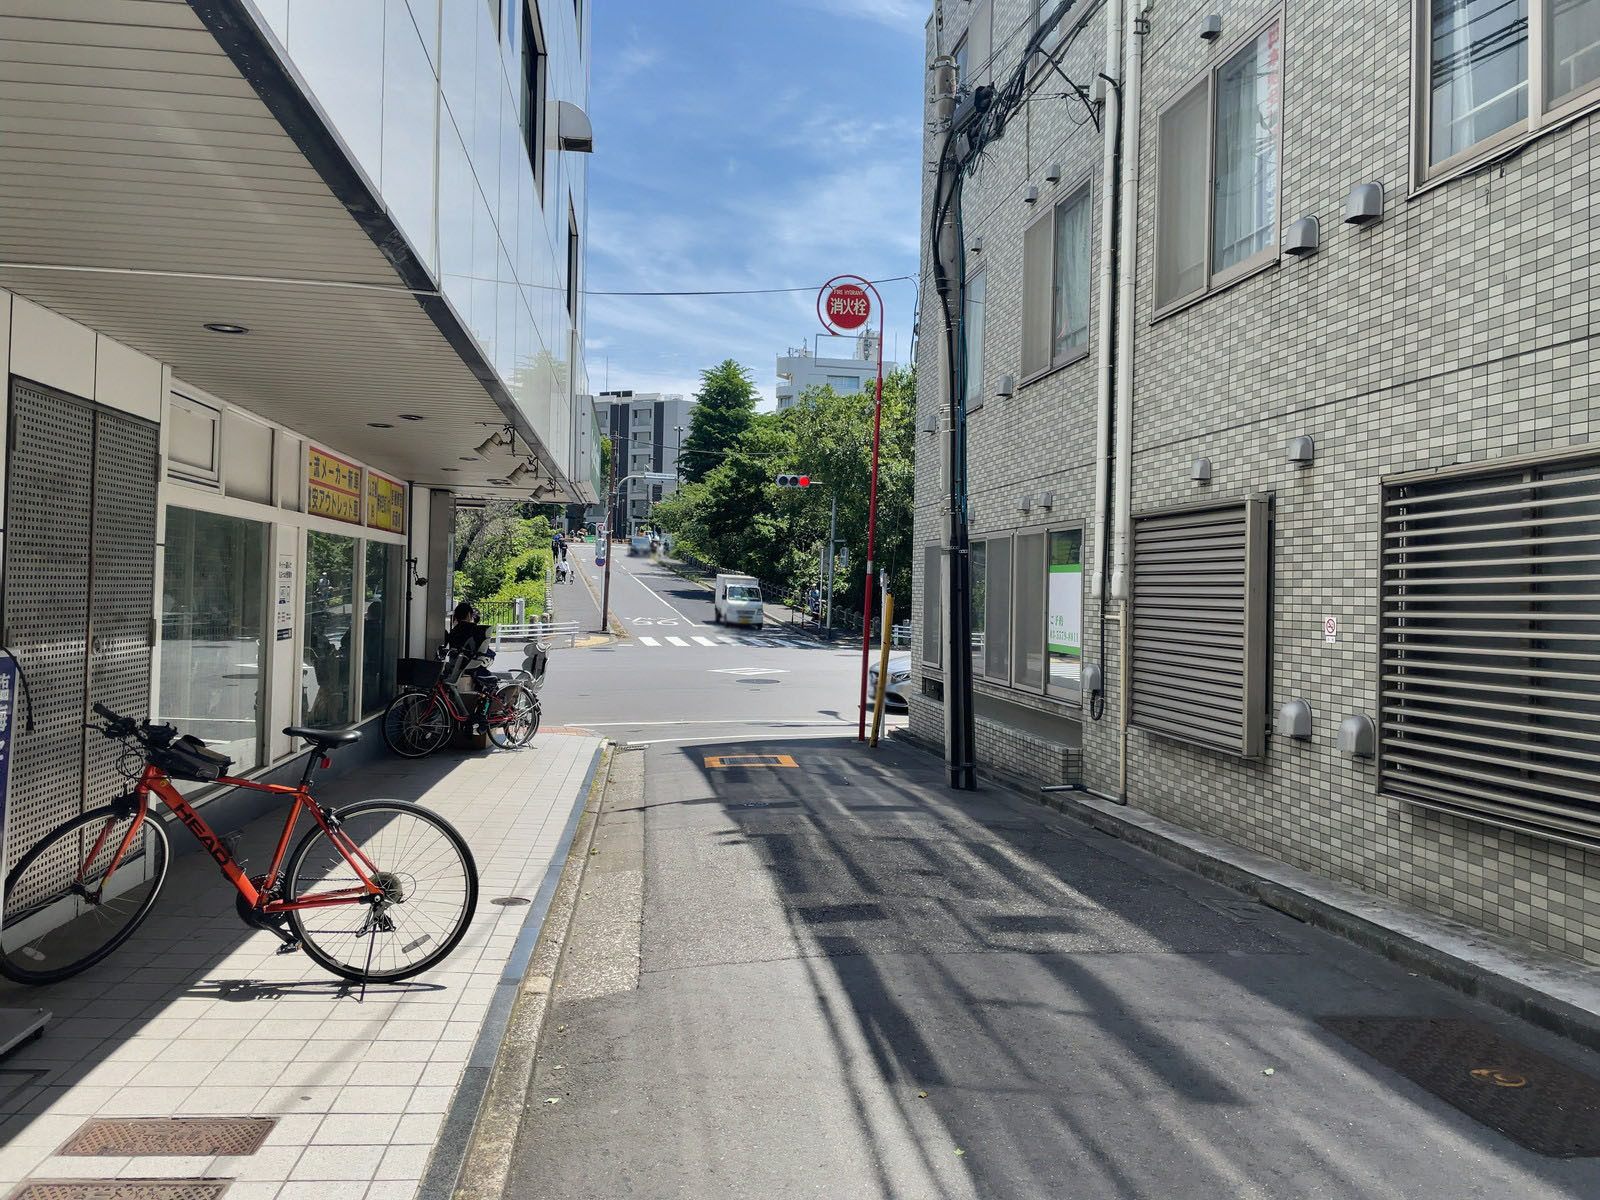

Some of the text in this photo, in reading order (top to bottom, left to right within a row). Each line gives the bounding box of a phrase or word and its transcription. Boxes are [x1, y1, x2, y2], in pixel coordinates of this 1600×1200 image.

[831, 297, 867, 315] 消火栓
[175, 804, 230, 865] HEAD
